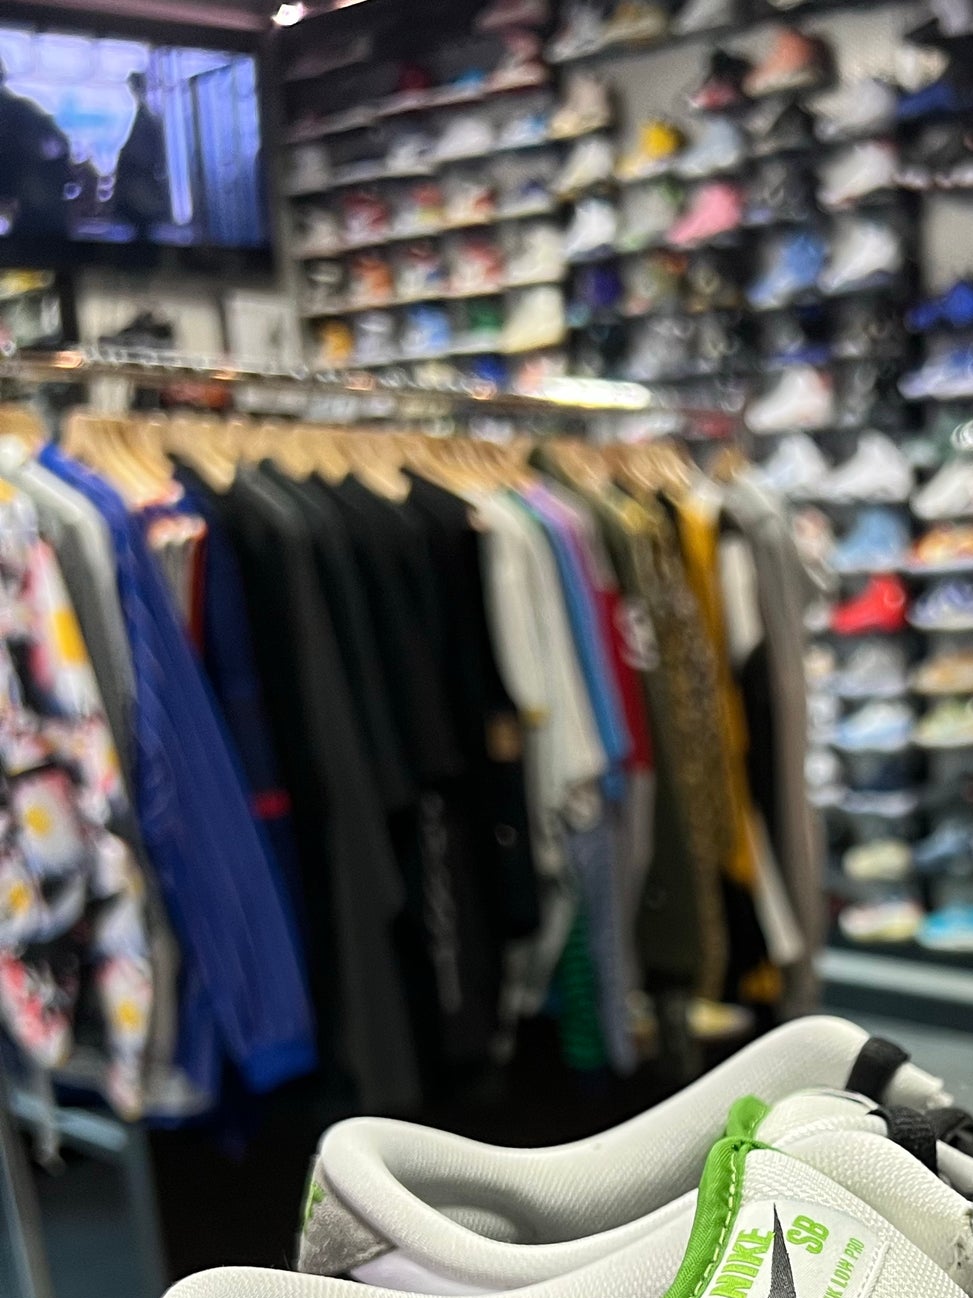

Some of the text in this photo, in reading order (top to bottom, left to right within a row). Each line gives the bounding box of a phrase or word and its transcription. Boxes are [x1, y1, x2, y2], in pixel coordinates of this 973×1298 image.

[786, 1215, 830, 1255] SB
[830, 1258, 855, 1289] LOW
[844, 1237, 865, 1260] PRO
